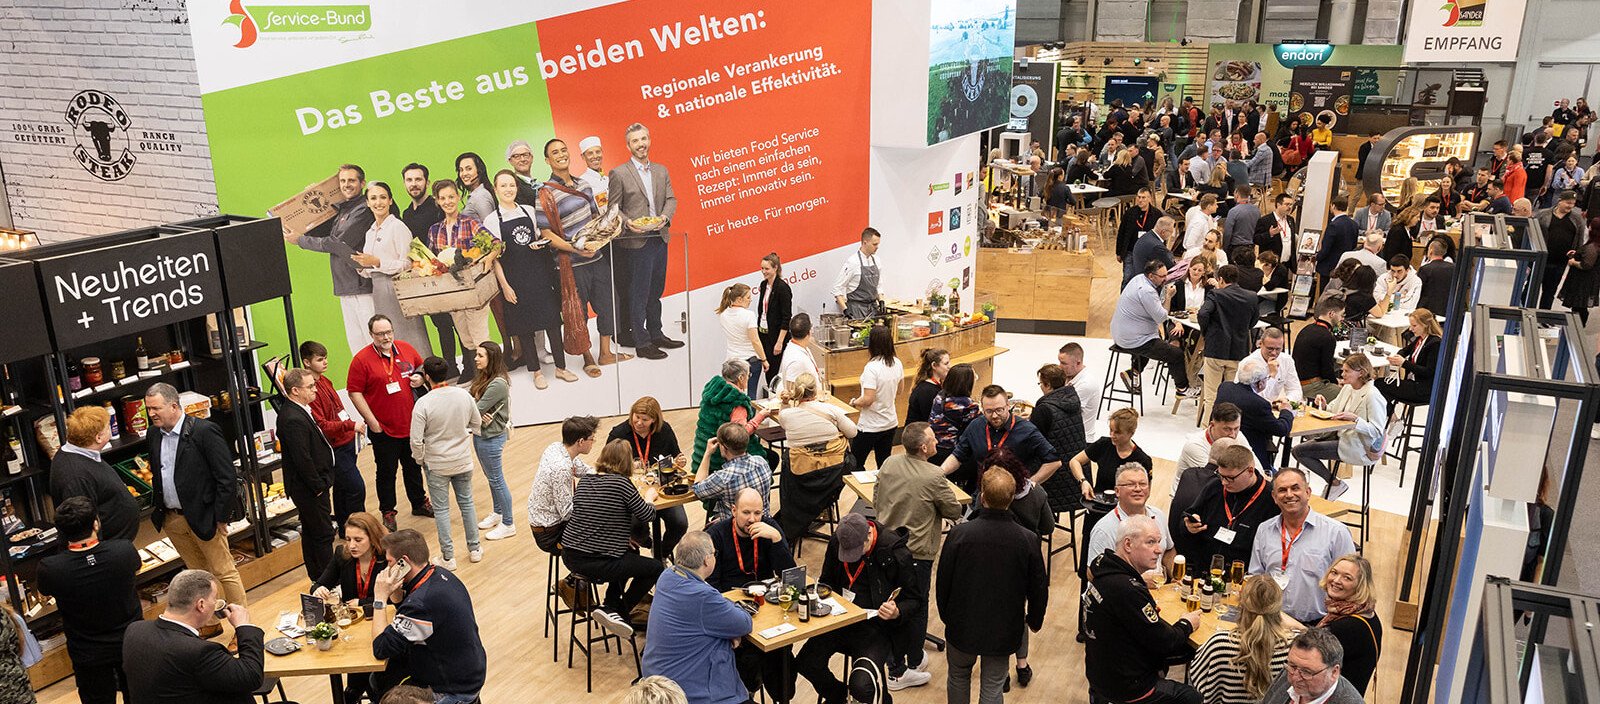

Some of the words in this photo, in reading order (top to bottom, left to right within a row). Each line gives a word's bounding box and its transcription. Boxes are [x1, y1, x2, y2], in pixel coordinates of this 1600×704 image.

[263, 10, 365, 30] Service-Bund
[1423, 36, 1503, 51] EMPFANG
[295, 105, 363, 136] Das
[370, 81, 465, 119] Beste
[476, 66, 529, 95] aus
[536, 39, 644, 81] beiden
[650, 9, 767, 53] Welten:
[641, 69, 721, 100] Regionale
[724, 46, 824, 79] Verankerung
[657, 103, 671, 119] &
[675, 85, 747, 115] nationale
[751, 62, 842, 95] Effektivität.
[12, 123, 35, 132] 100%
[38, 124, 64, 133] GRAS-
[67, 92, 127, 126] RODEO
[14, 134, 67, 144] GEFÜTTERT
[139, 142, 182, 152] QUALITY
[142, 131, 176, 141] RANCH
[690, 154, 711, 169] Wir
[713, 146, 749, 163] bieten
[751, 135, 779, 153] Food
[781, 128, 820, 145] Service
[77, 150, 135, 178] STEAK
[694, 166, 721, 183] nach
[723, 159, 756, 175] einem
[759, 144, 811, 165] einfachen
[697, 176, 740, 196] Rezept:
[743, 166, 778, 184] Immer
[781, 160, 795, 173] da
[797, 154, 823, 168] sein,
[700, 192, 736, 210] immer
[738, 178, 788, 199] innovativ
[790, 170, 815, 185] sein.
[706, 223, 725, 236] Für
[727, 214, 763, 230] heute.
[764, 206, 782, 220] Für
[785, 197, 830, 215] morgen.
[54, 251, 210, 304] Neuheiten
[77, 311, 95, 329] +
[102, 280, 205, 325] Trends
